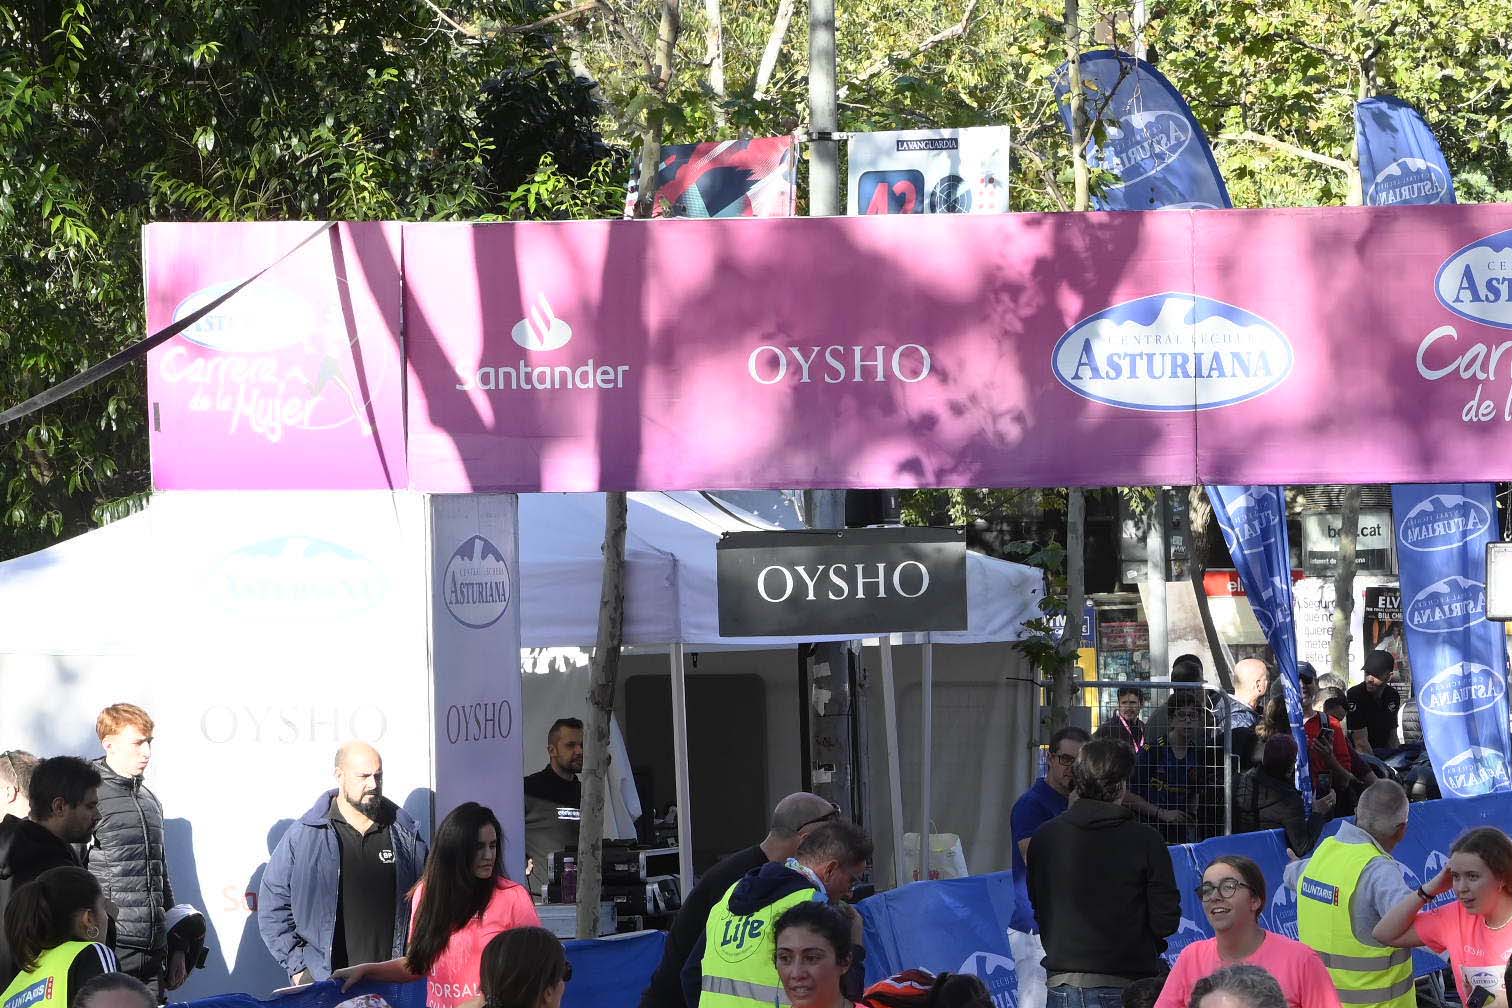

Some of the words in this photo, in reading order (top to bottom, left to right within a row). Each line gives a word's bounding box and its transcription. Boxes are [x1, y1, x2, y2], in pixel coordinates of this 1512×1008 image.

[456, 360, 629, 391] Santander
[747, 343, 931, 384] OYSHO
[1071, 337, 1273, 380] ASTURIANA
[1462, 383, 1497, 423] de
[448, 570, 507, 606] ASTURIANA
[757, 560, 930, 602] OYSHO
[200, 703, 387, 745] OYSHO
[446, 700, 512, 745] OYSHO
[720, 914, 762, 949] Life
